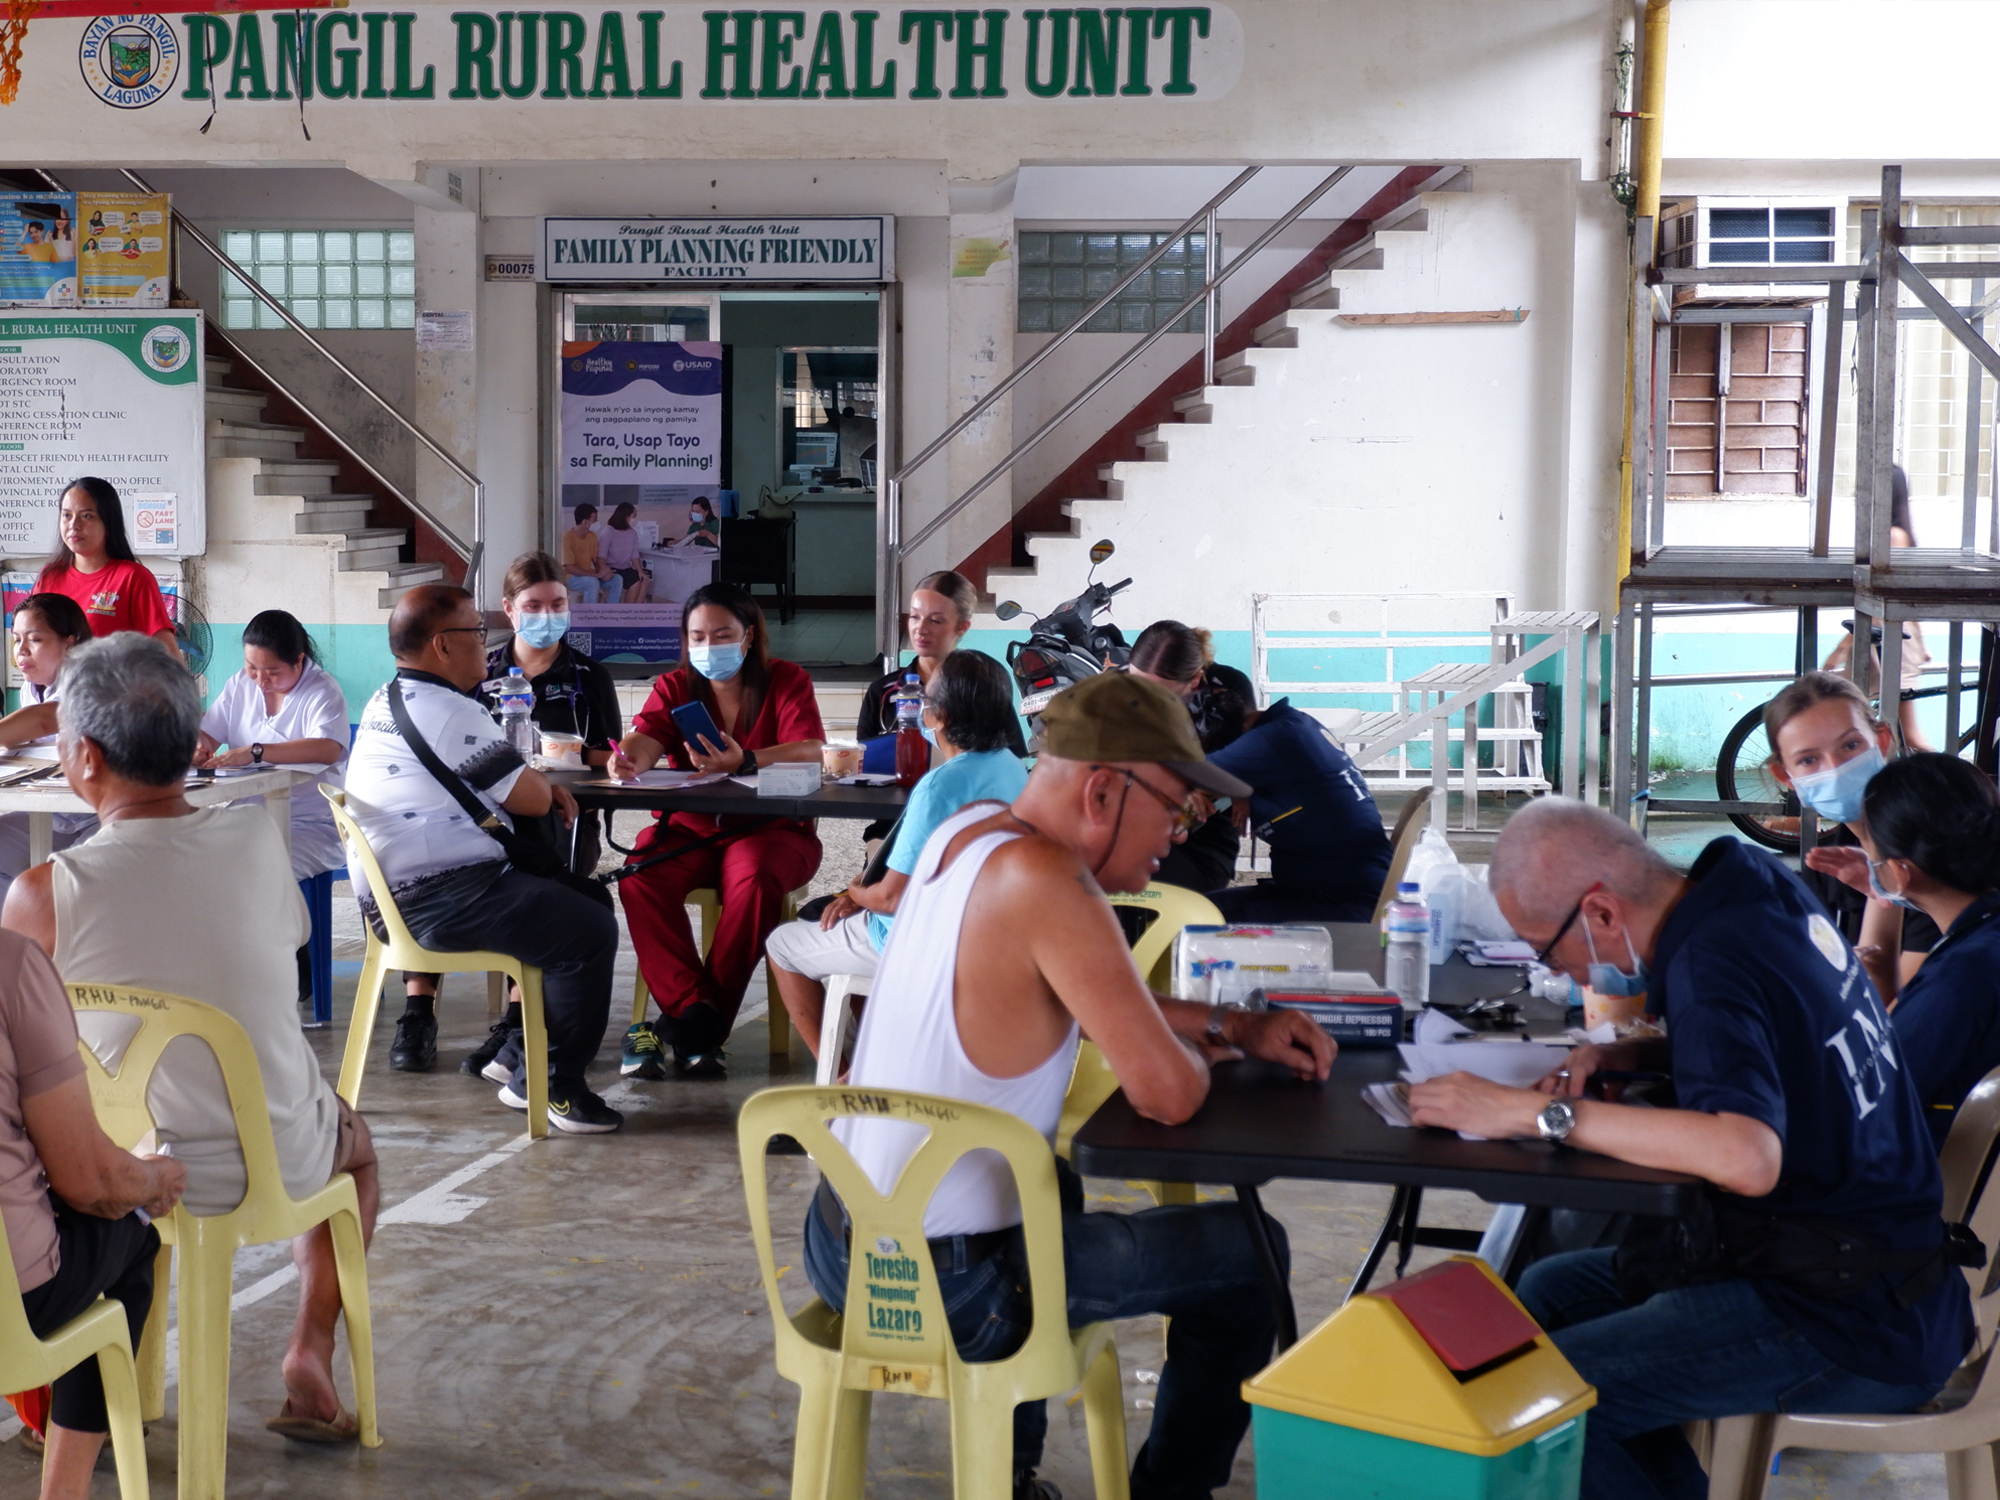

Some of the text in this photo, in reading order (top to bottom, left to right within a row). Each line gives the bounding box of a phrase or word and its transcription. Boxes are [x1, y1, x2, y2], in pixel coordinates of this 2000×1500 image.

[84, 15, 114, 59] BAYAN
[138, 14, 176, 59] PANGIL
[181, 7, 1211, 101] PANGIL RURAL HEALTH UNIT
[103, 83, 161, 104] LAGUNA
[619, 224, 801, 240] Pangil Rural Health Unit
[554, 239, 879, 264] FAMILY PLANNING FRIENDLY
[498, 263, 535, 275] 00075
[664, 266, 750, 278] FACILITY
[12, 324, 51, 335] RURAL
[54, 324, 103, 334] HEALTH
[106, 323, 138, 334] UNIT
[0, 356, 60, 364] SULTATION
[685, 360, 712, 369] USAID
[45, 377, 77, 386] ROOM
[13, 400, 32, 408] STC
[33, 411, 90, 419] CESSATION
[92, 411, 127, 419] CLINIC
[614, 406, 631, 415] n'yo
[644, 406, 672, 415] inyong
[674, 406, 700, 415] kamay
[50, 422, 82, 430] ROOM
[603, 416, 651, 425] pagpaplano
[653, 417, 663, 425] ng
[665, 416, 699, 425] pamilya.
[41, 433, 76, 441] OFFICE
[583, 433, 701, 449] Tara, Usap Tayo
[40, 454, 85, 463] FRIENDLY
[88, 454, 125, 462] HEALTH
[128, 454, 169, 462] FACILITY
[570, 454, 713, 470] sa Family Planning!
[24, 465, 56, 473] CLINIC
[130, 477, 162, 485] OFFICE
[3, 522, 35, 530] OFFICE
[1313, 1013, 1393, 1026] TONGUE DEPRESSOR
[865, 1252, 920, 1283] Teresita
[865, 1283, 921, 1304] "Ningning"
[868, 1302, 923, 1334] Lazaro
